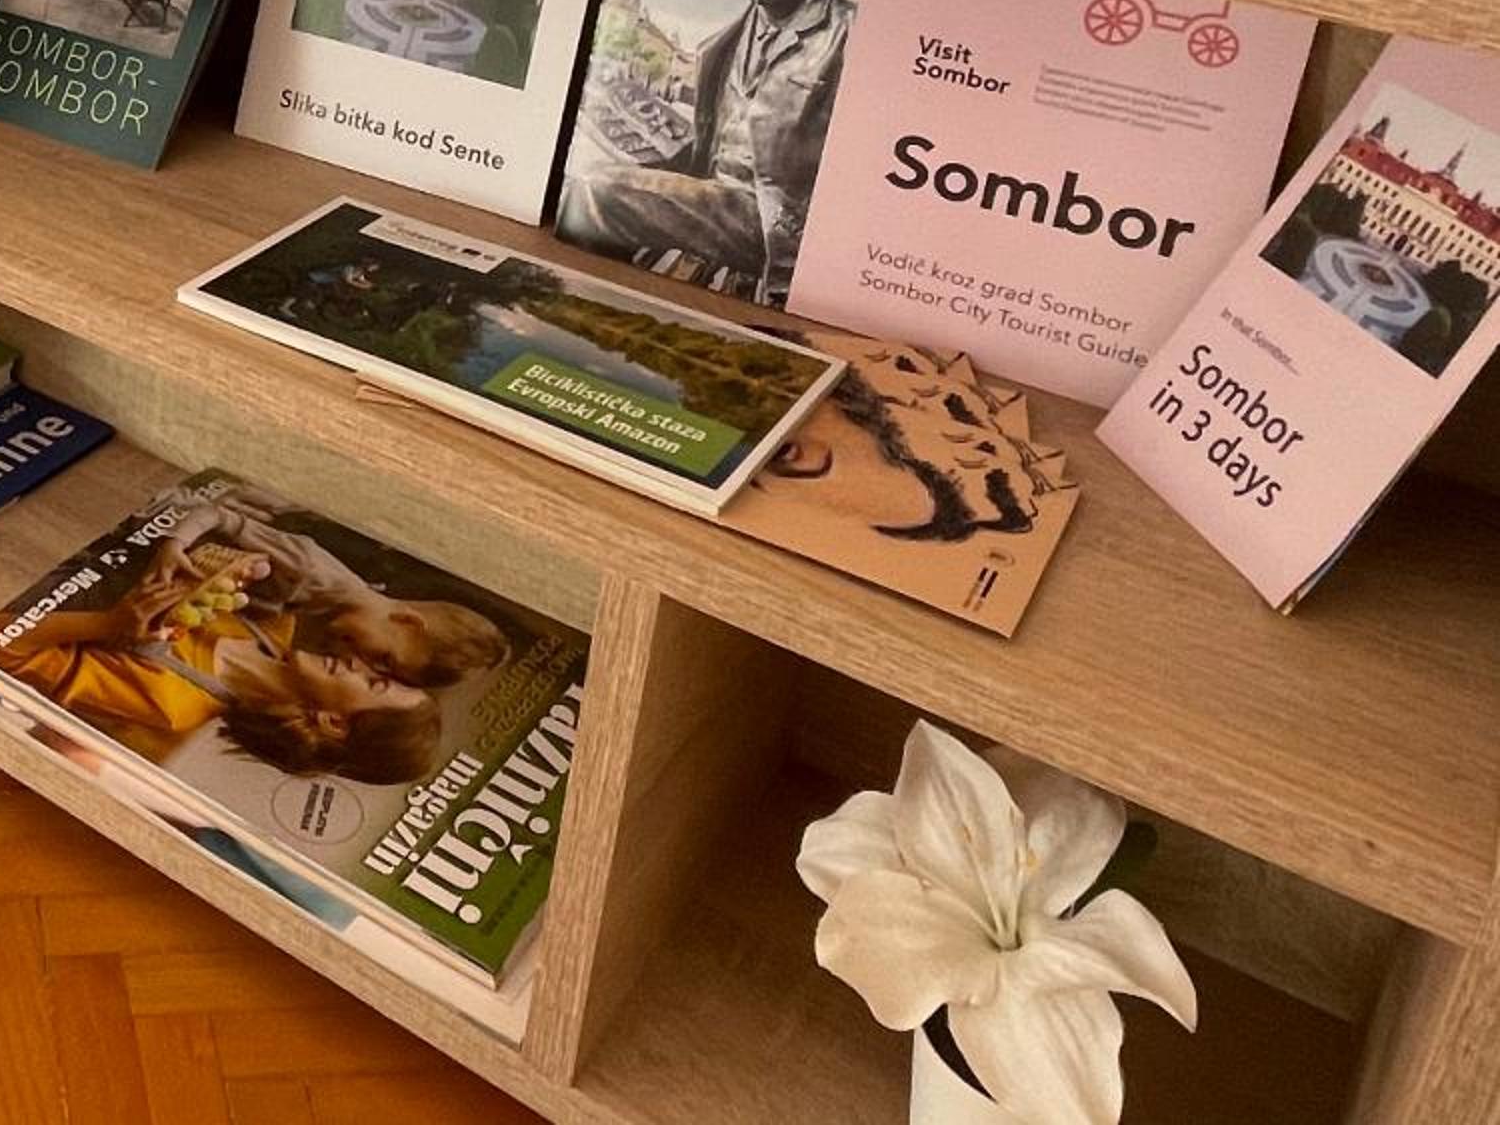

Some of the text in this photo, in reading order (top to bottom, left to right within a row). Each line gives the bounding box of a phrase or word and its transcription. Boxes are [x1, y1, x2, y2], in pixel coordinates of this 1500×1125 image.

[912, 56, 1011, 94] Sombor
[918, 35, 973, 64] Visit
[279, 88, 506, 171] Slika bitka kod Sente
[886, 134, 1196, 258] Sombor
[859, 269, 1150, 369] Sombor City Tourist Guide
[867, 242, 1133, 334] Vodič kroz grad Sombor
[506, 377, 682, 455] Evropski Amazon
[524, 363, 708, 443] Biciklistička staza
[1149, 380, 1283, 508] in 3 days
[1179, 344, 1305, 455] Sombor
[363, 751, 485, 875] magazin
